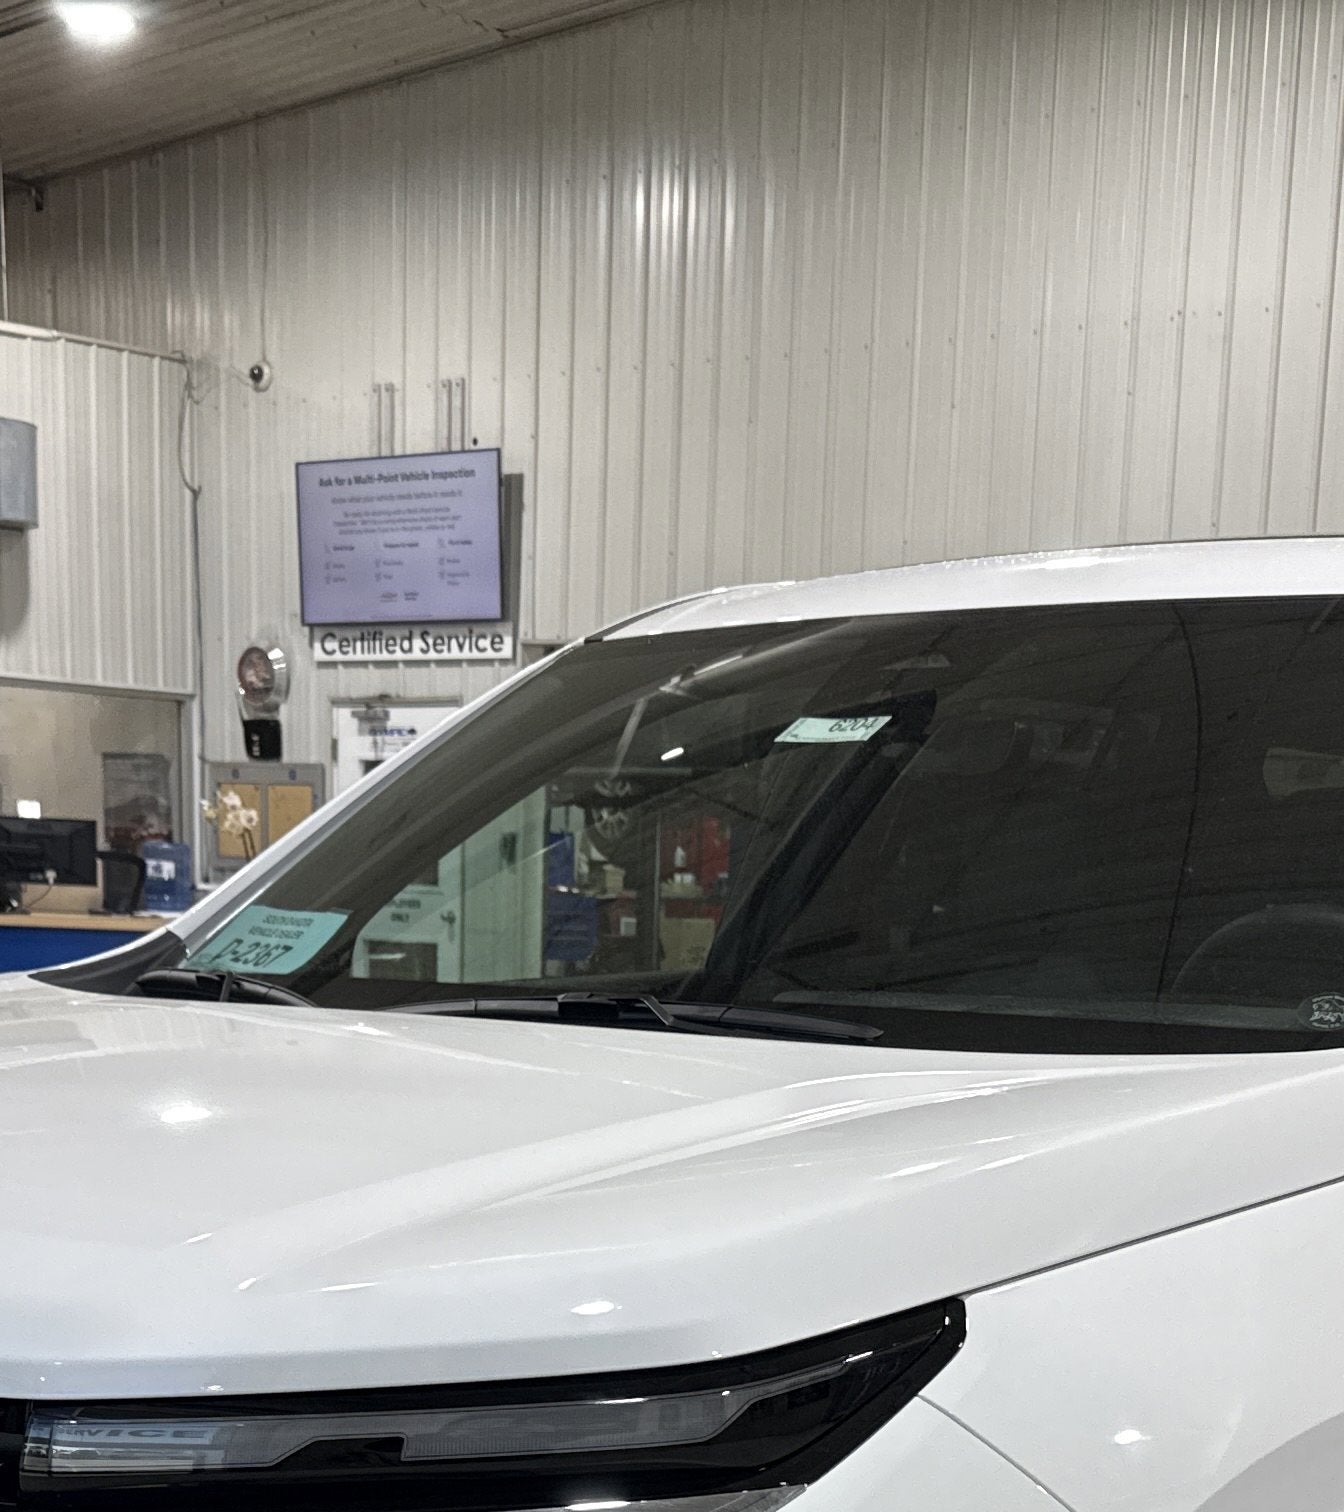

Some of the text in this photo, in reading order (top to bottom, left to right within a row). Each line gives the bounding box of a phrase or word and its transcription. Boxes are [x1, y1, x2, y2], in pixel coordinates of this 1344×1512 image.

[319, 477, 333, 487] Ask
[334, 476, 346, 486] for
[354, 472, 400, 485] Multi-Point
[401, 469, 430, 482] Vehicle
[431, 466, 476, 481] Inspection
[320, 628, 505, 656] Certified Service
